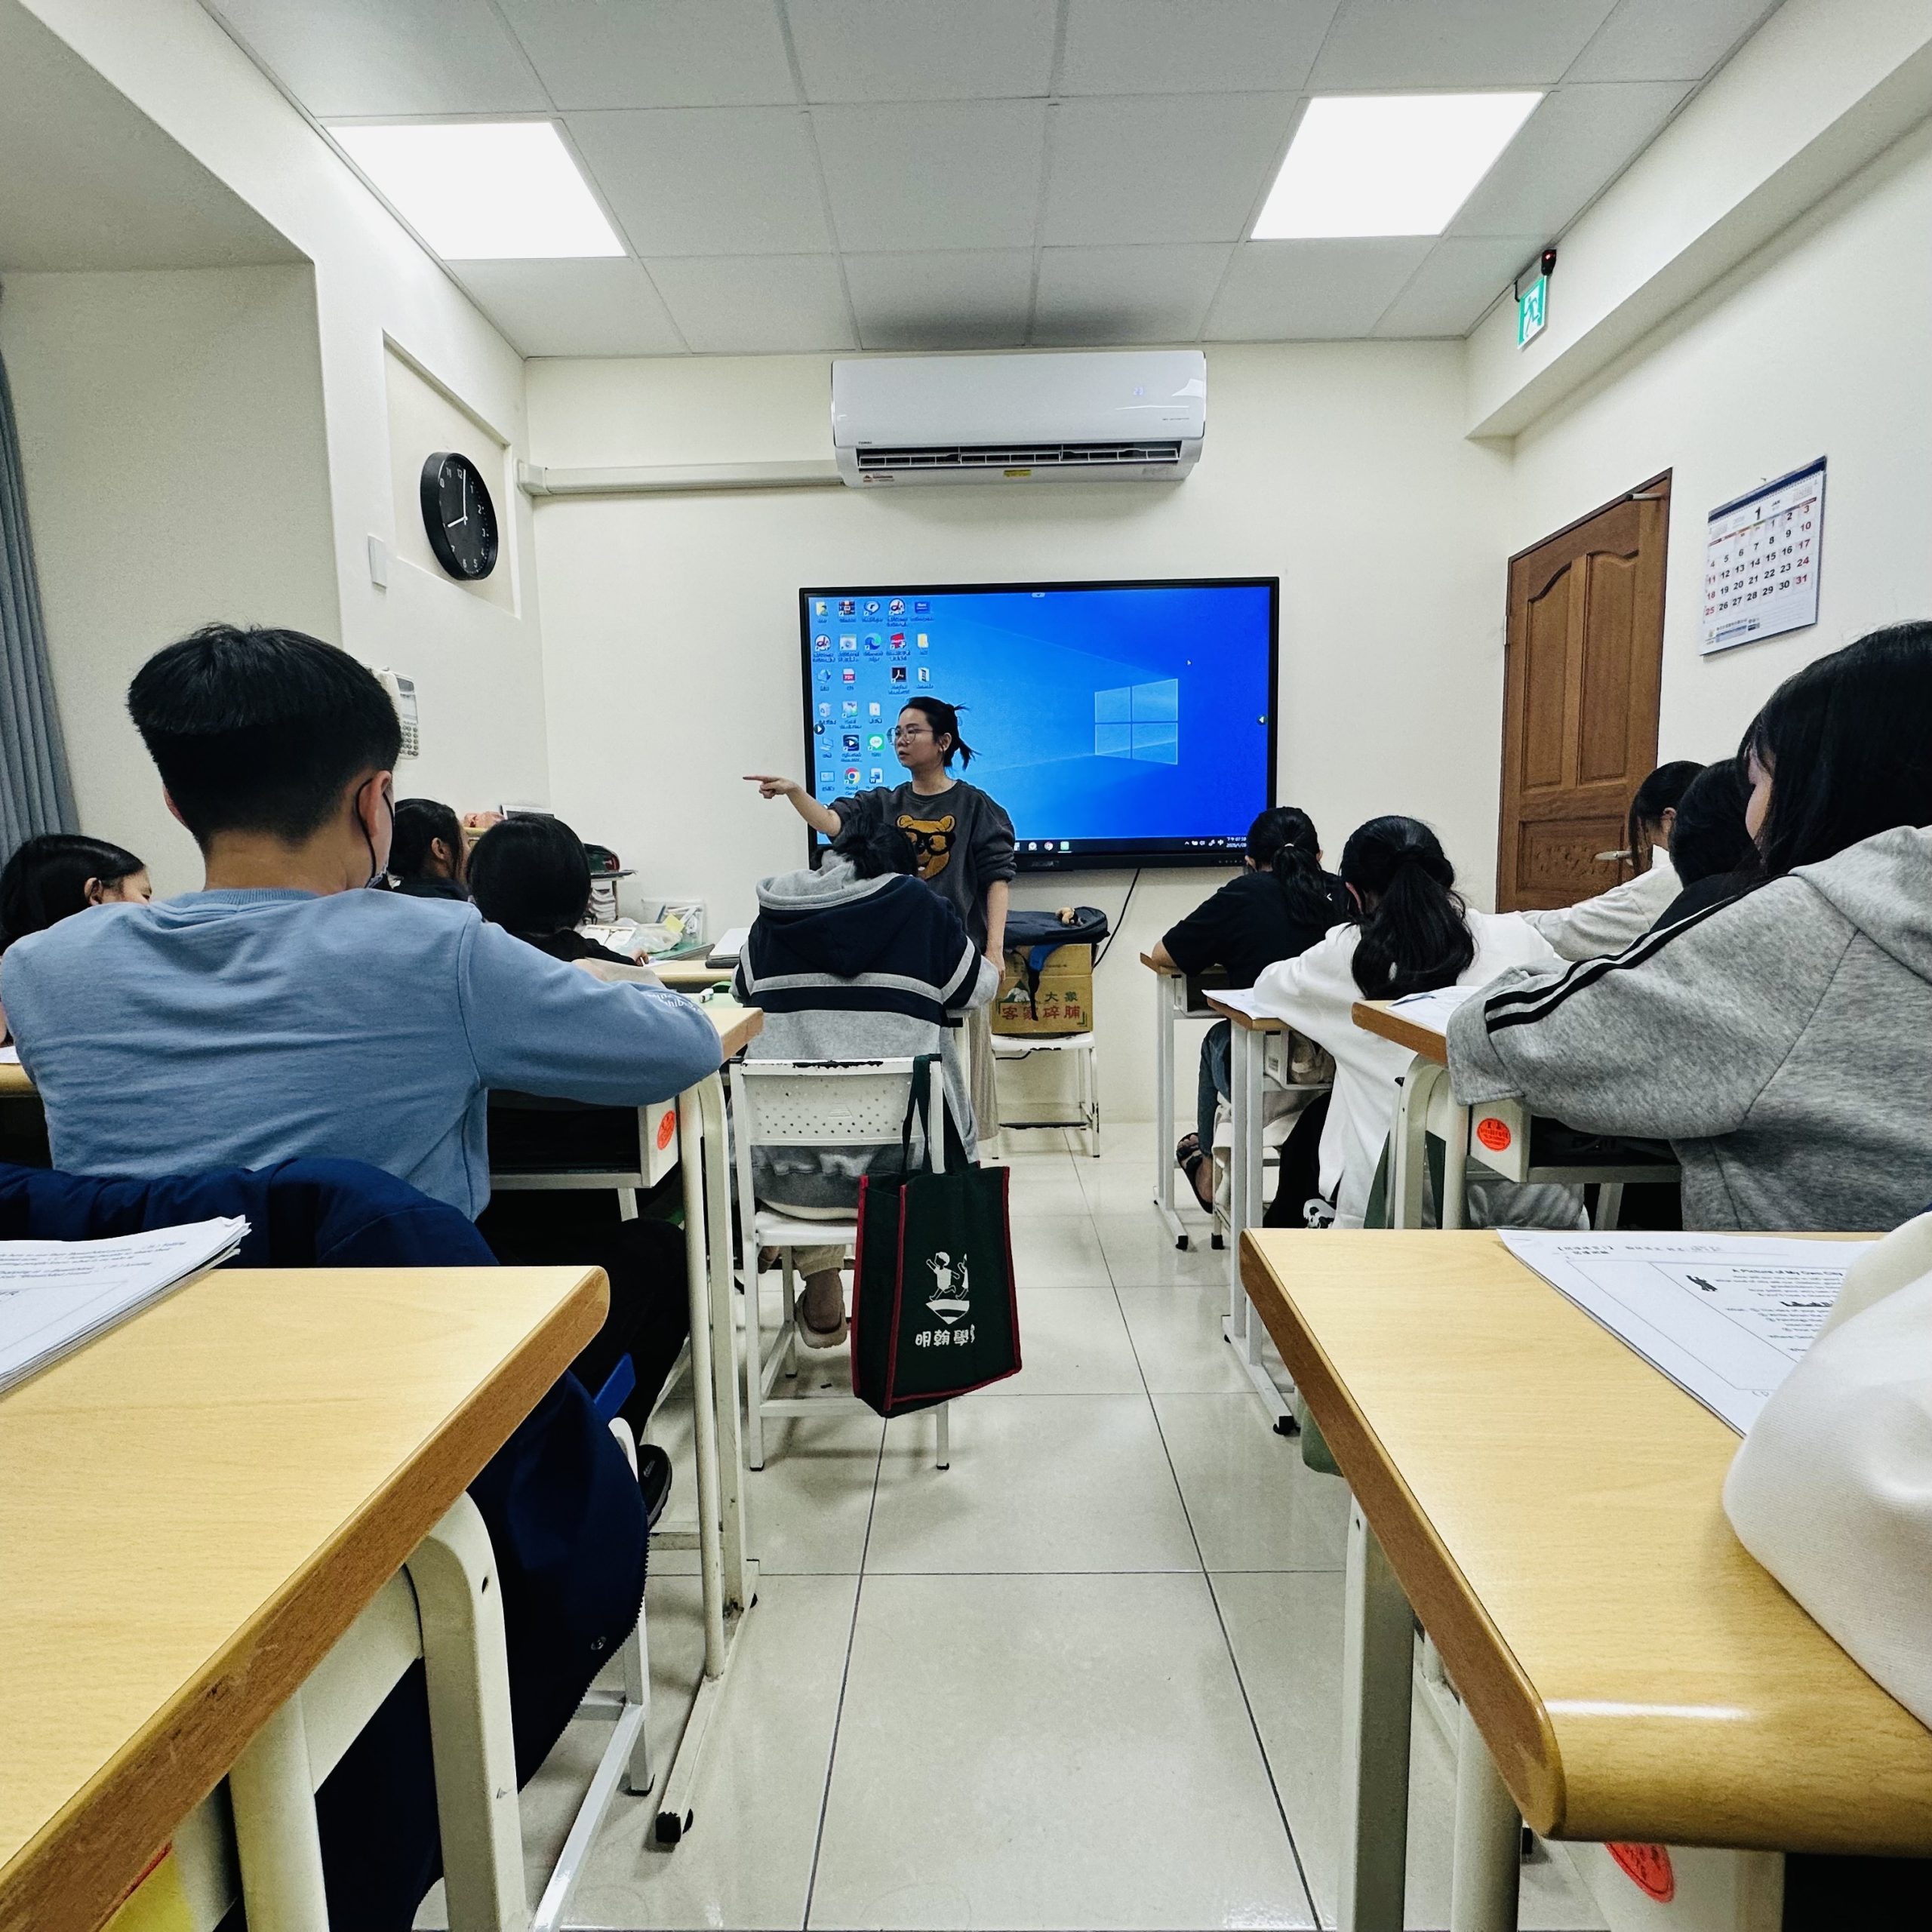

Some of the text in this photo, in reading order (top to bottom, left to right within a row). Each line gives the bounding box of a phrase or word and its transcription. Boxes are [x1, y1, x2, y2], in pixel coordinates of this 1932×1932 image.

[477, 504, 481, 514] 2
[1755, 506, 1761, 521] 1
[1786, 512, 1792, 521] 2
[1804, 505, 1810, 514] 3
[1724, 554, 1729, 563] 5
[1739, 549, 1744, 557] 6
[1754, 542, 1759, 550] 7
[1769, 536, 1774, 544] 8
[1786, 529, 1792, 537] 9
[1800, 521, 1811, 531] 10
[473, 558, 478, 568] 5
[1708, 538, 1810, 584] 11 12 13 14 15 16 17
[1707, 556, 1809, 600] 18 19 20 21 22 23 24
[1706, 574, 1807, 616] 25 26 27 28 29 30 31
[915, 1324, 976, 1348] 明翰學
